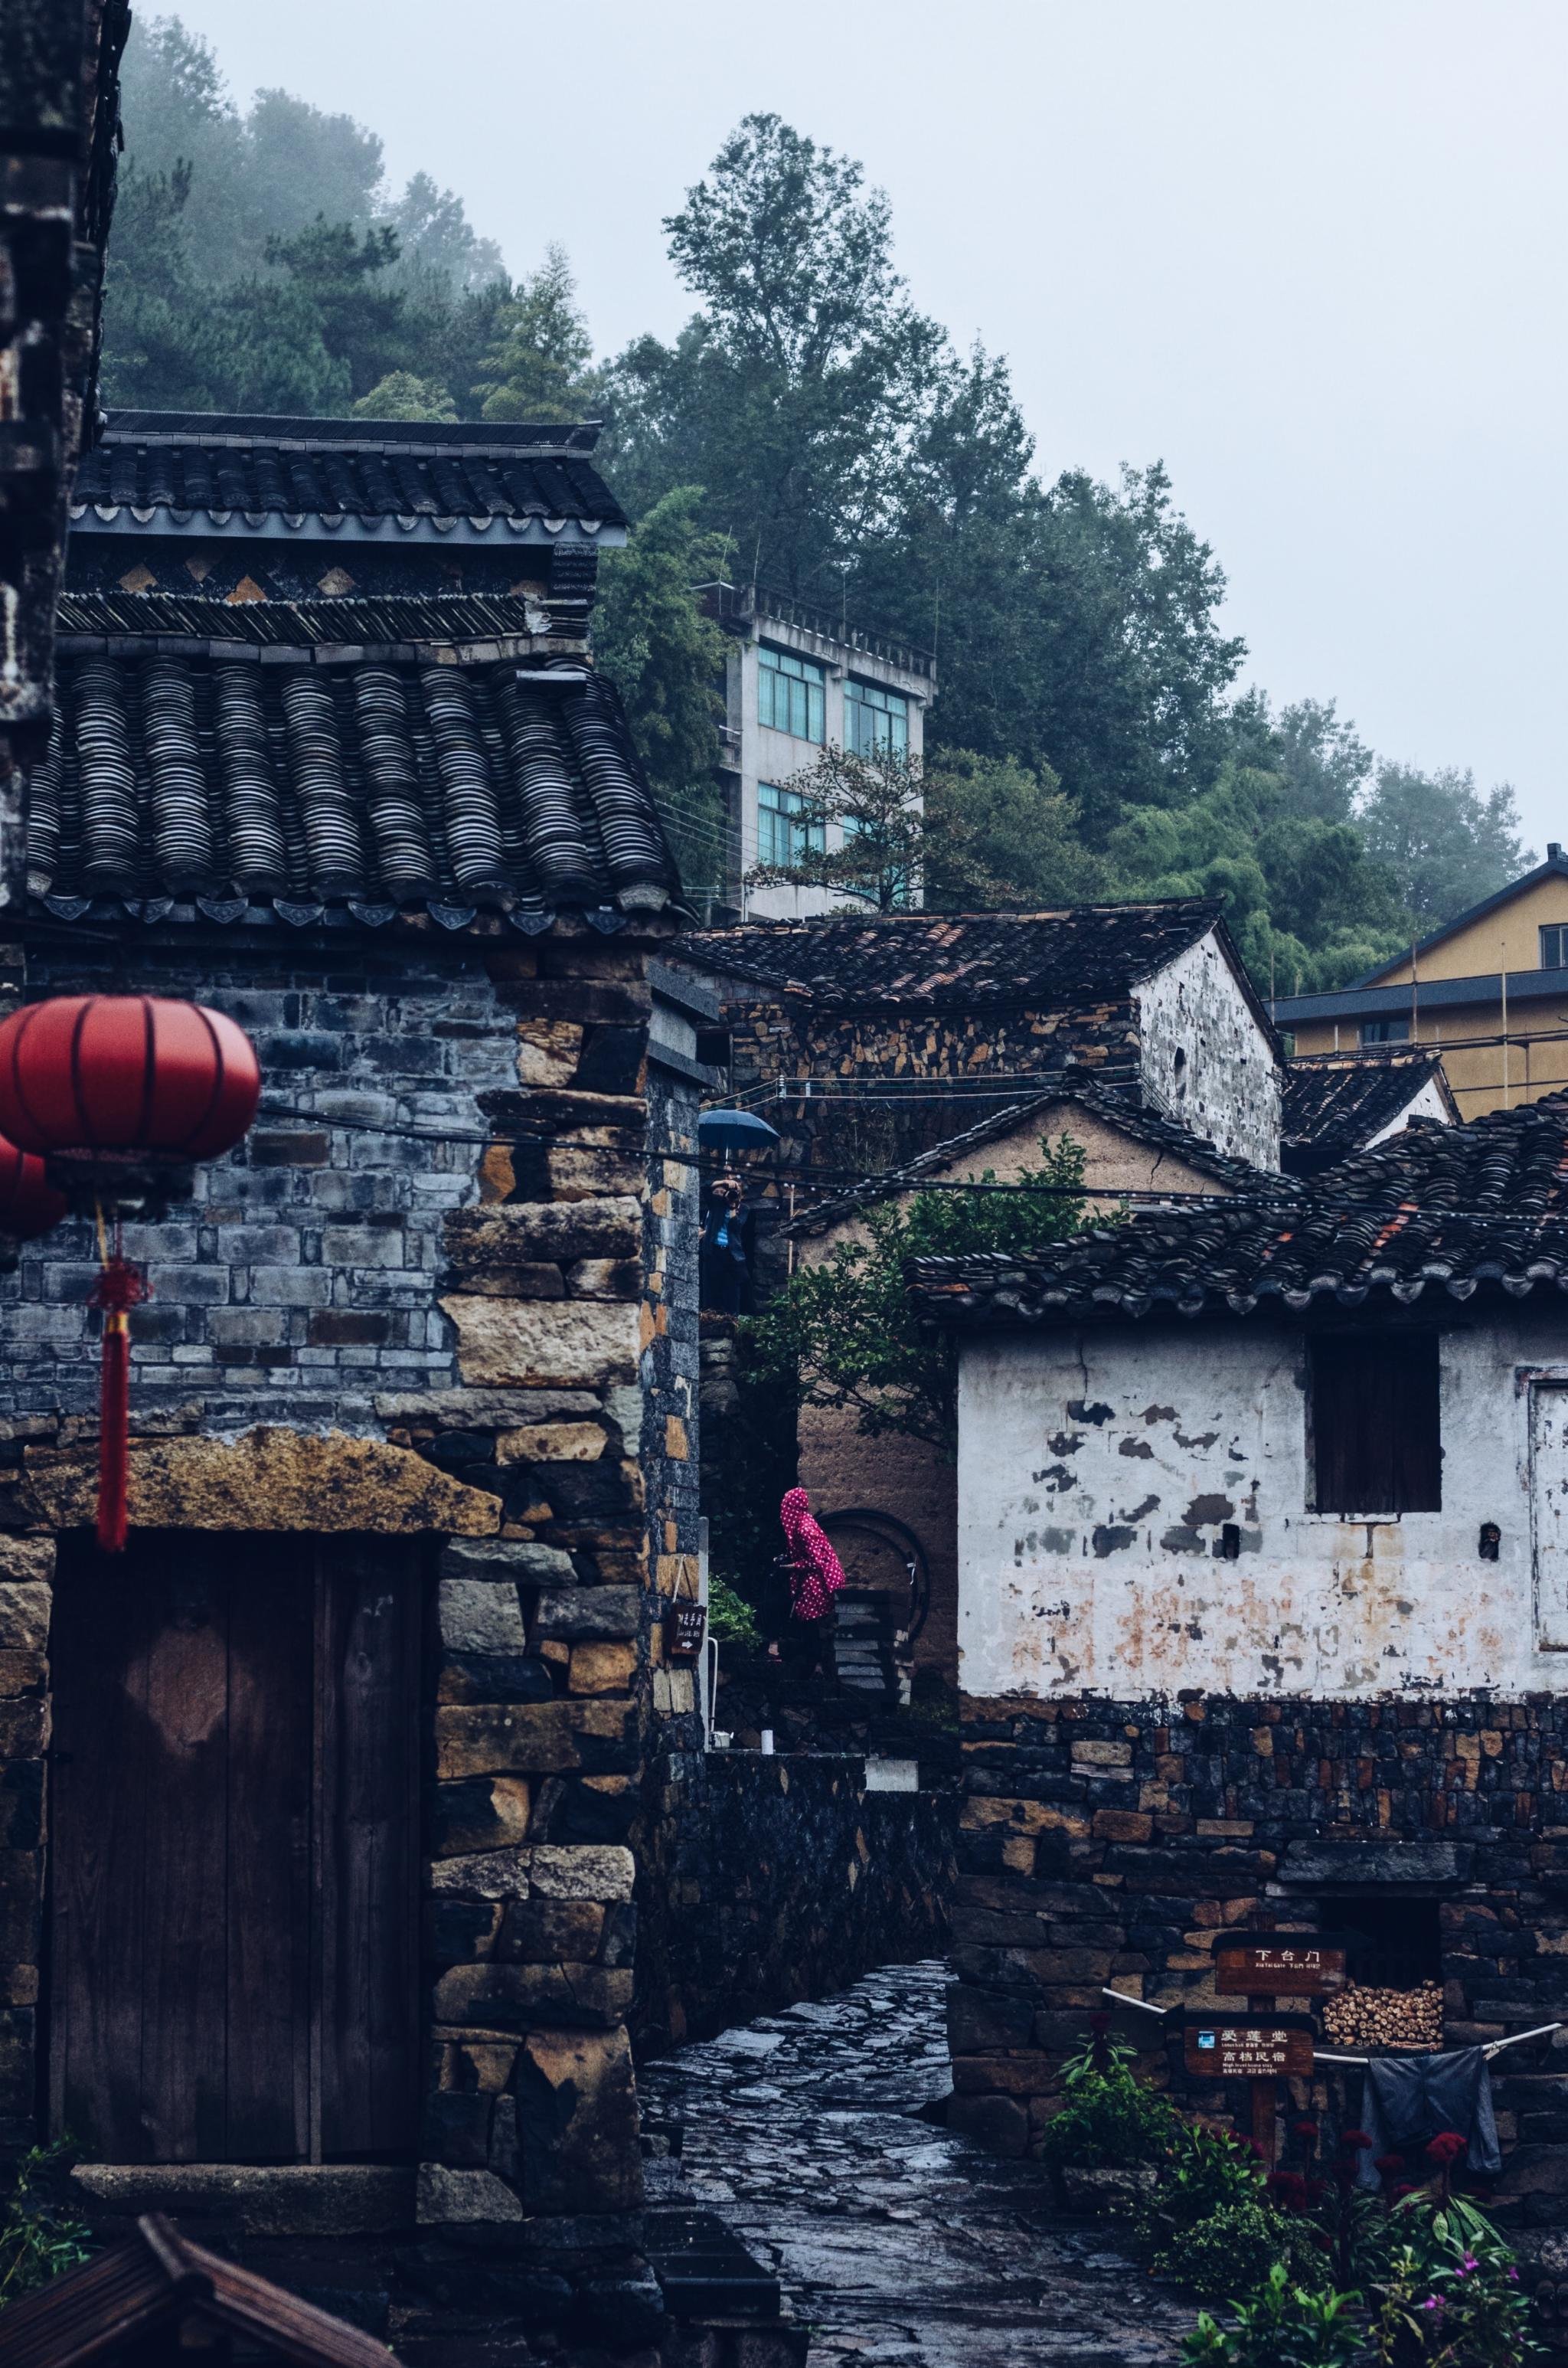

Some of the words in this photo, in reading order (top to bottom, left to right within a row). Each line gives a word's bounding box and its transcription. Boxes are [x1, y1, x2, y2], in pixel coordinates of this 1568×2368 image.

[1256, 1950, 1320, 1962] 下台门
[1223, 2051, 1286, 2062] 高档民宿
